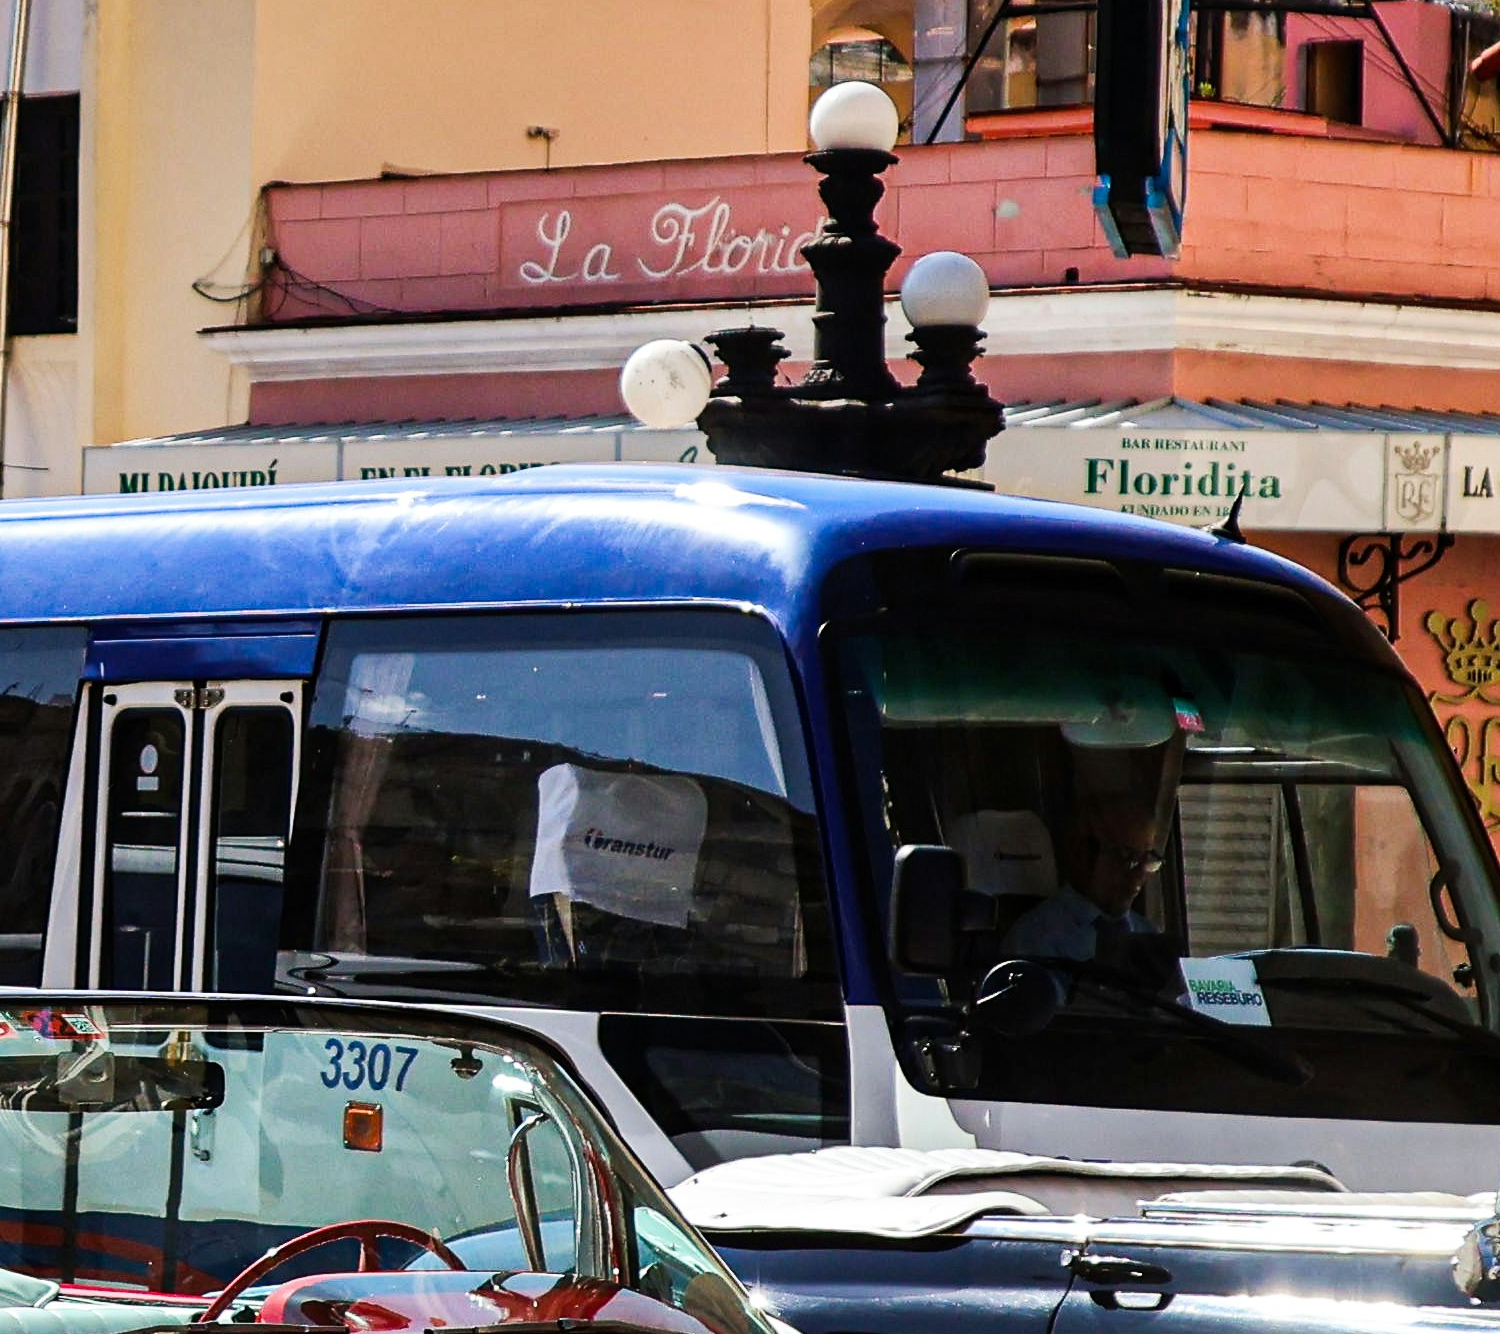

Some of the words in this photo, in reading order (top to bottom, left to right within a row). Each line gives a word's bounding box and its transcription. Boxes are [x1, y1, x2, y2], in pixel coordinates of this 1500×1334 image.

[519, 210, 620, 283] La
[637, 195, 832, 278] Florid
[1121, 437, 1151, 450] BAR
[1154, 439, 1248, 452] RESTAURANT
[1083, 457, 1282, 499] Floridita
[1463, 465, 1494, 499] LA
[1193, 505, 1211, 517] EN
[320, 1037, 420, 1092] 3307
